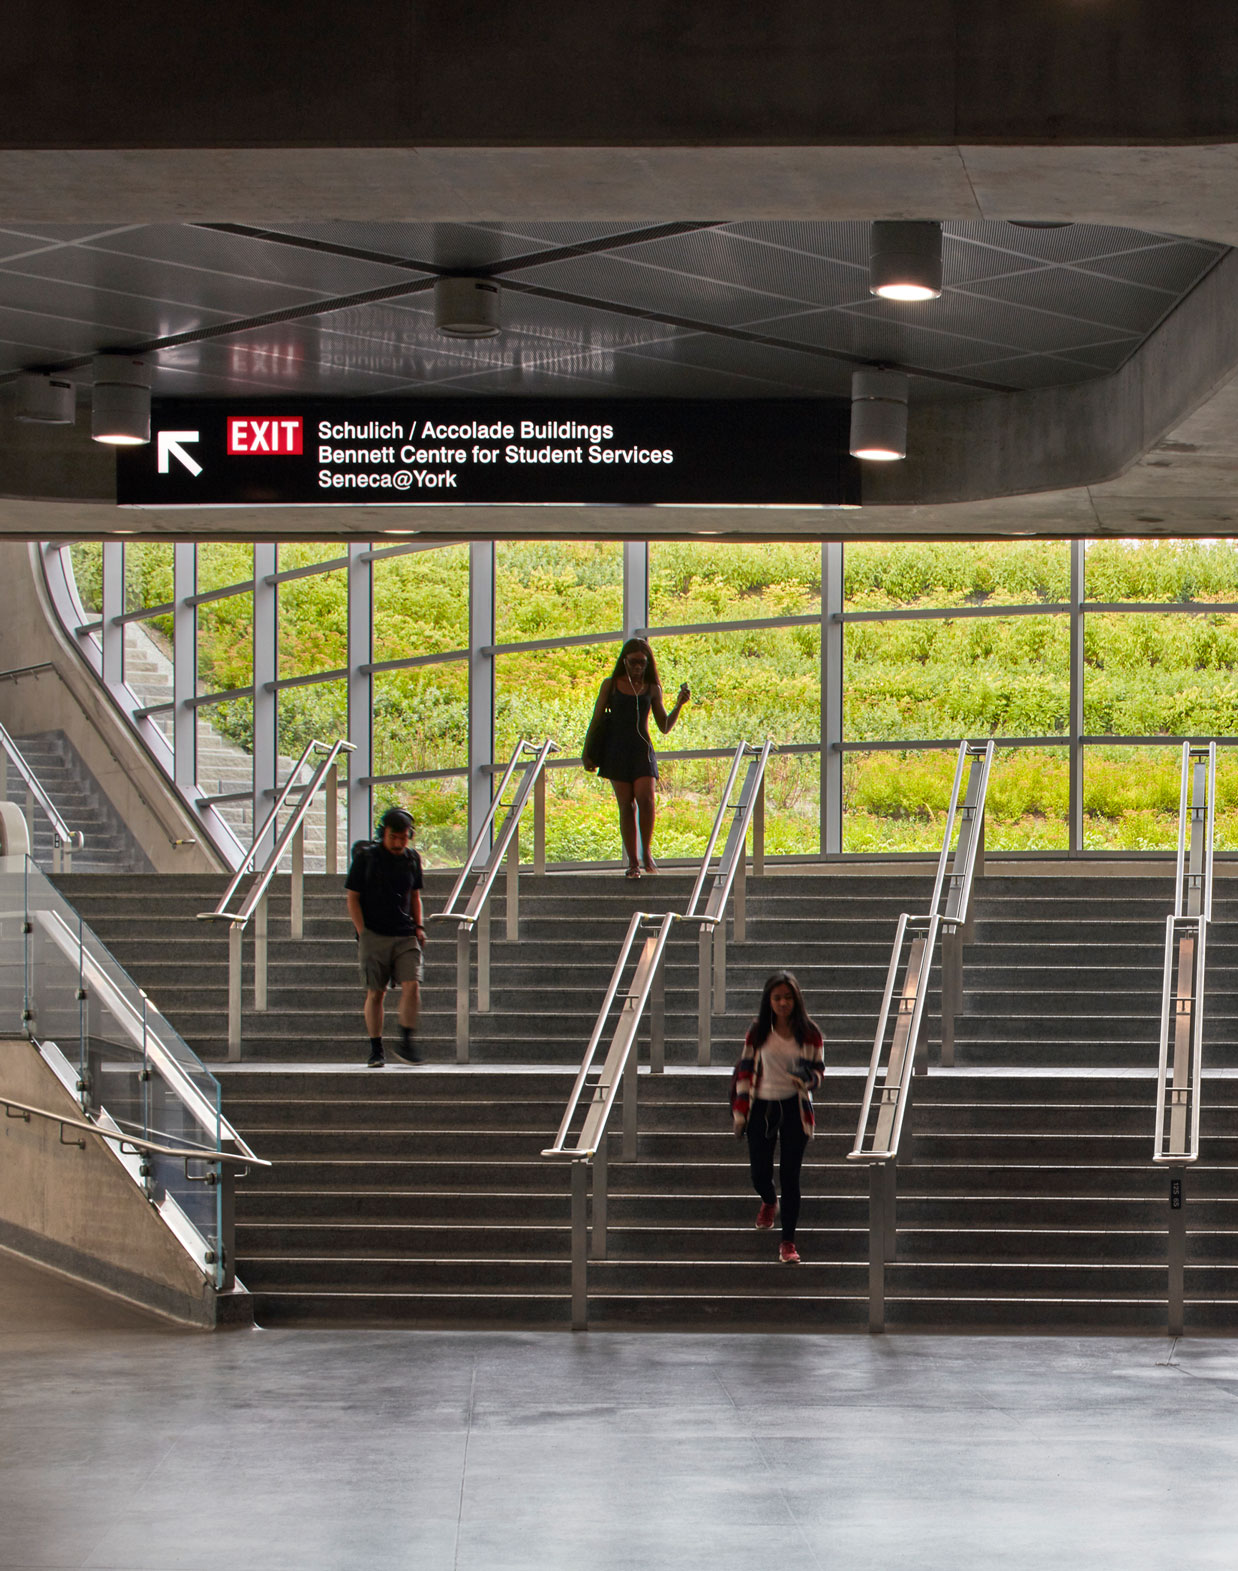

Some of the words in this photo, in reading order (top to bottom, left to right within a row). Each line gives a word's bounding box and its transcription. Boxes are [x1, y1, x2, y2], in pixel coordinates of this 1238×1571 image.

[232, 421, 299, 451] EXIT
[319, 421, 403, 440] Schulich
[409, 421, 416, 440] /
[422, 421, 514, 440] Accolade
[521, 421, 613, 444] Buildings
[319, 445, 395, 464] Bennett
[401, 445, 466, 464] Centre
[472, 445, 499, 464] for
[506, 445, 582, 464] Student
[589, 445, 673, 464] Services
[319, 469, 456, 490] Seneca@York
